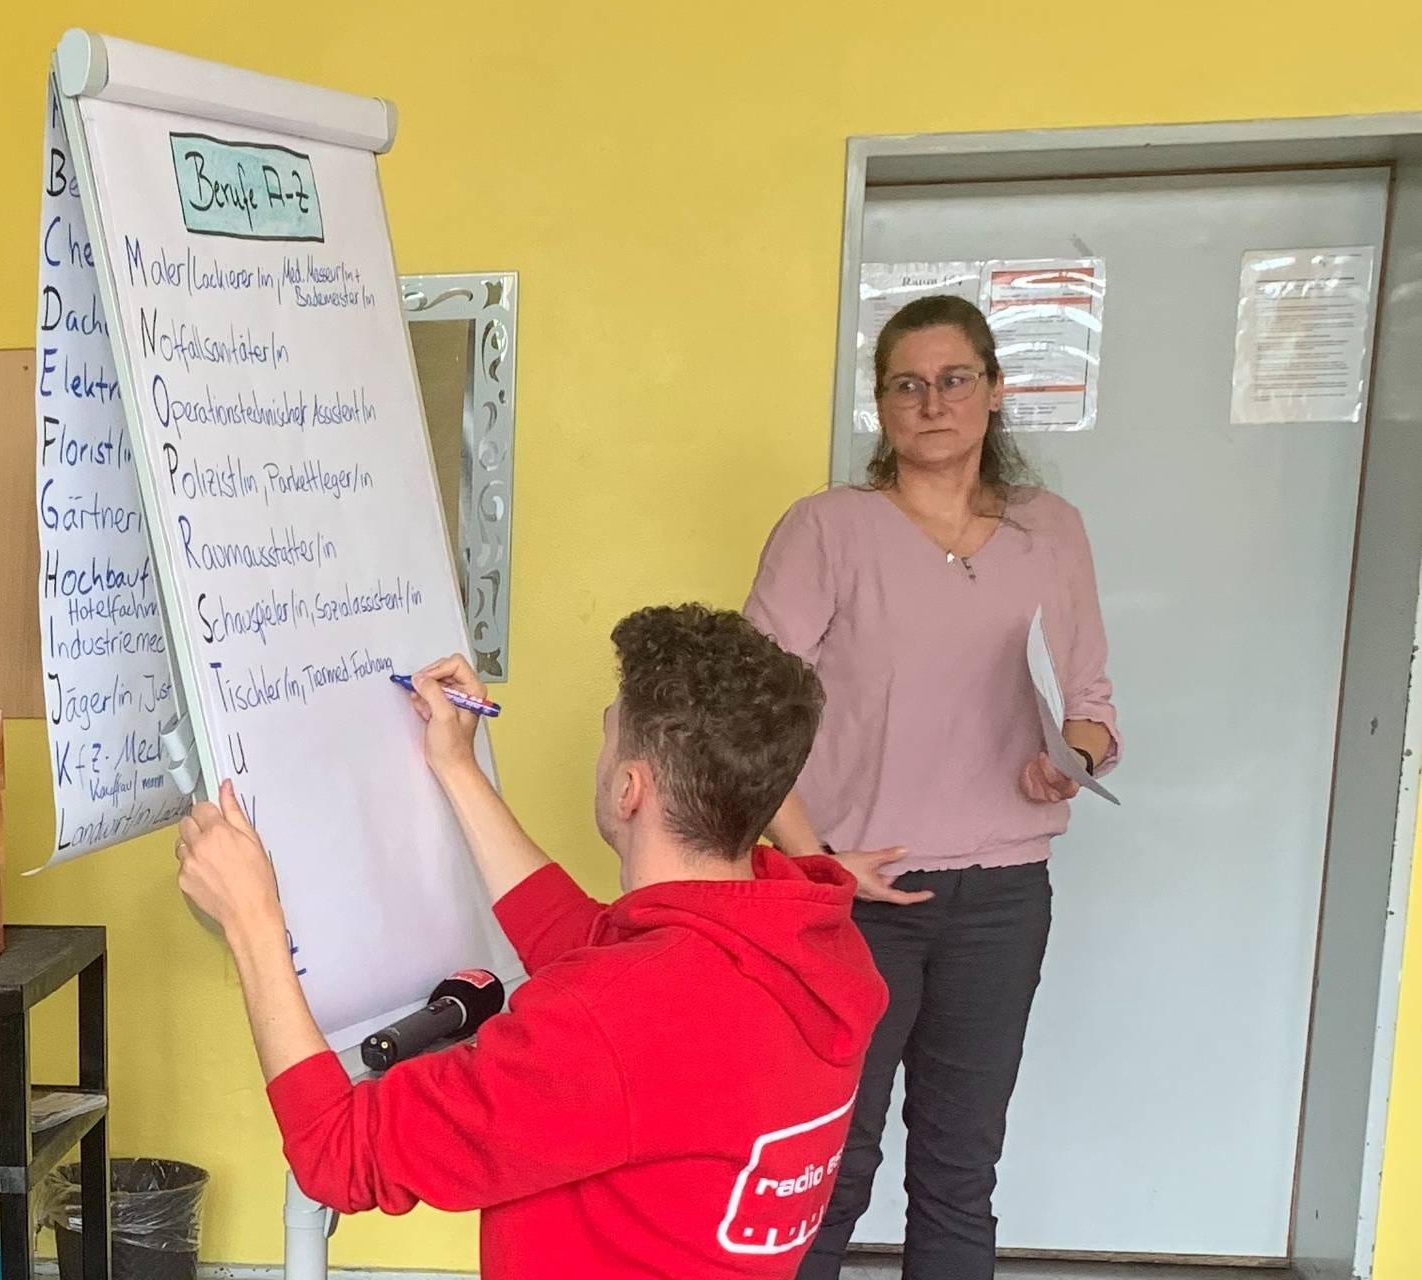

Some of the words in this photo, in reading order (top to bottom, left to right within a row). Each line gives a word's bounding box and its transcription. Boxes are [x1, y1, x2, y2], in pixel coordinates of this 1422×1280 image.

[184, 151, 258, 232] Berufe
[262, 165, 309, 214] A-Z
[140, 307, 289, 371] Notfallsanitäter/in
[178, 515, 337, 570] Raumausstatter/in
[314, 576, 422, 621] Sozialassistent/in
[227, 732, 249, 775] U
[755, 1163, 824, 1197] radio
